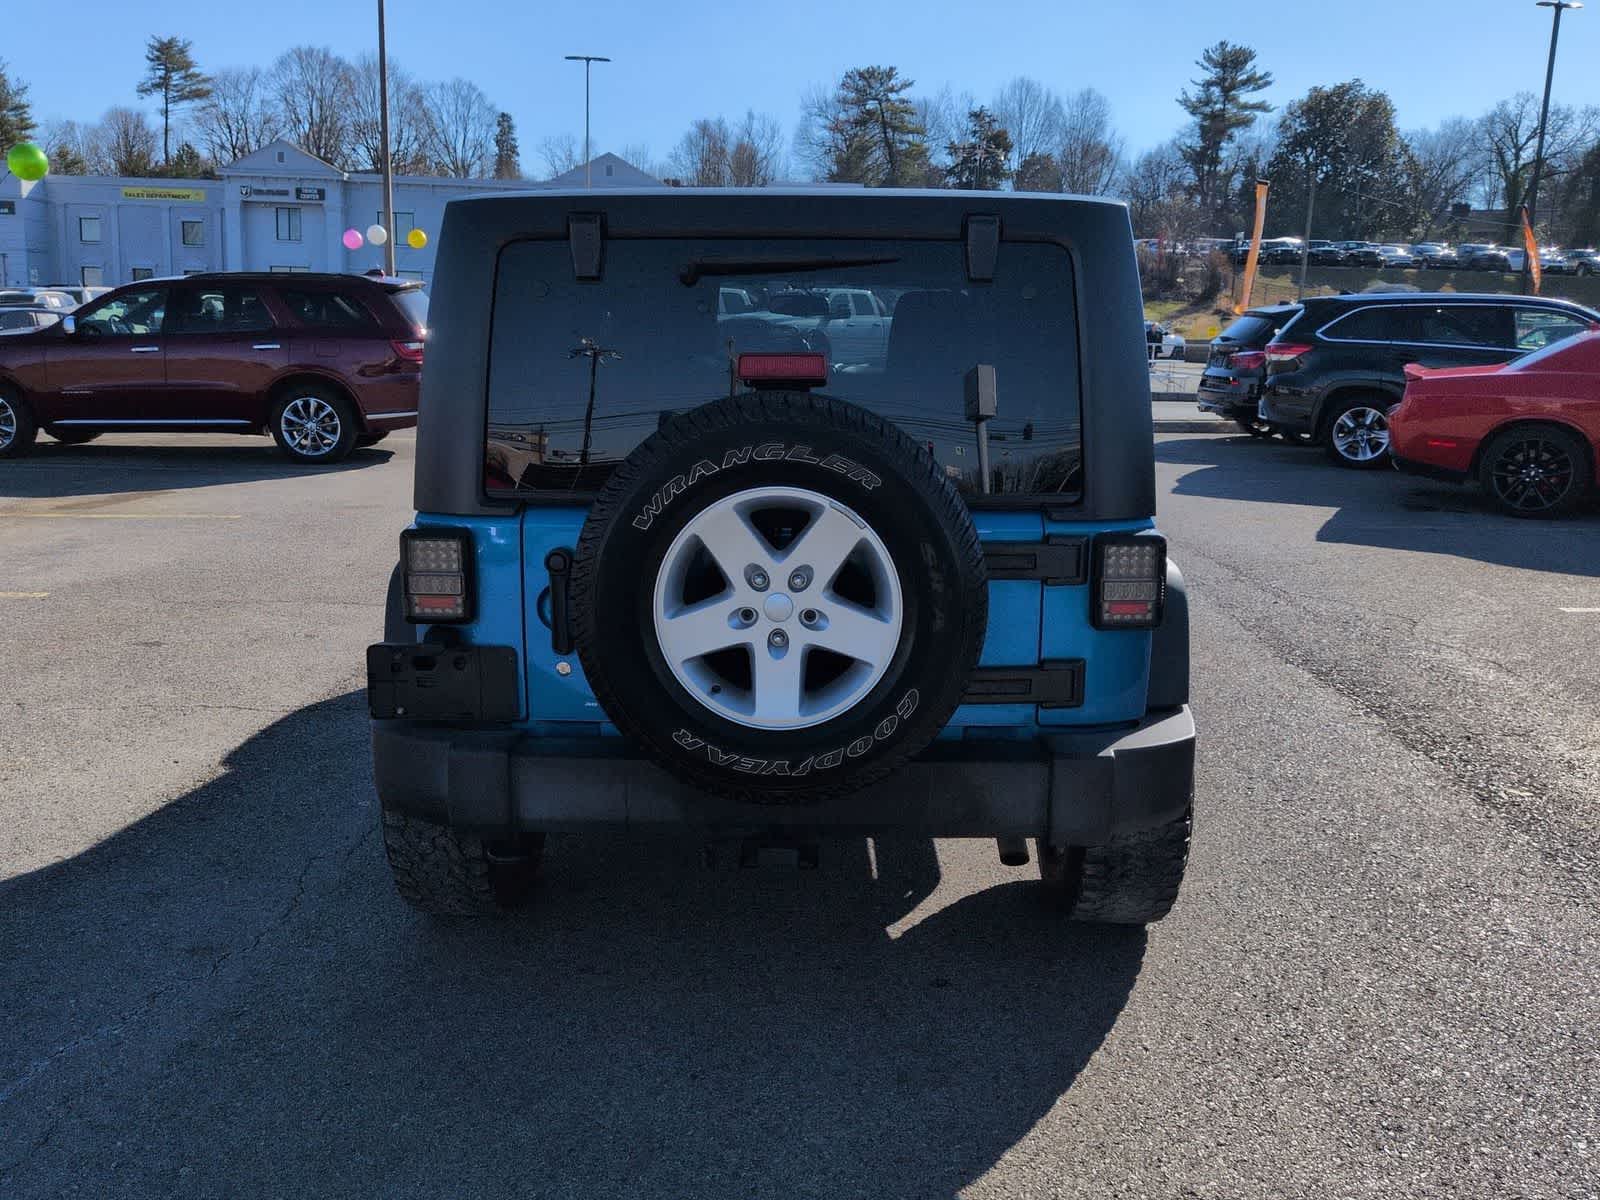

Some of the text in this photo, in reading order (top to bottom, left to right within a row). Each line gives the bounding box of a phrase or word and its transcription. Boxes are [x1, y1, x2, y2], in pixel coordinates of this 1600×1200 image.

[124, 190, 145, 198] SALES
[146, 191, 191, 200] DEPARTMENT
[632, 443, 882, 530] WRANGLER
[672, 688, 920, 776] GOODYEAR
